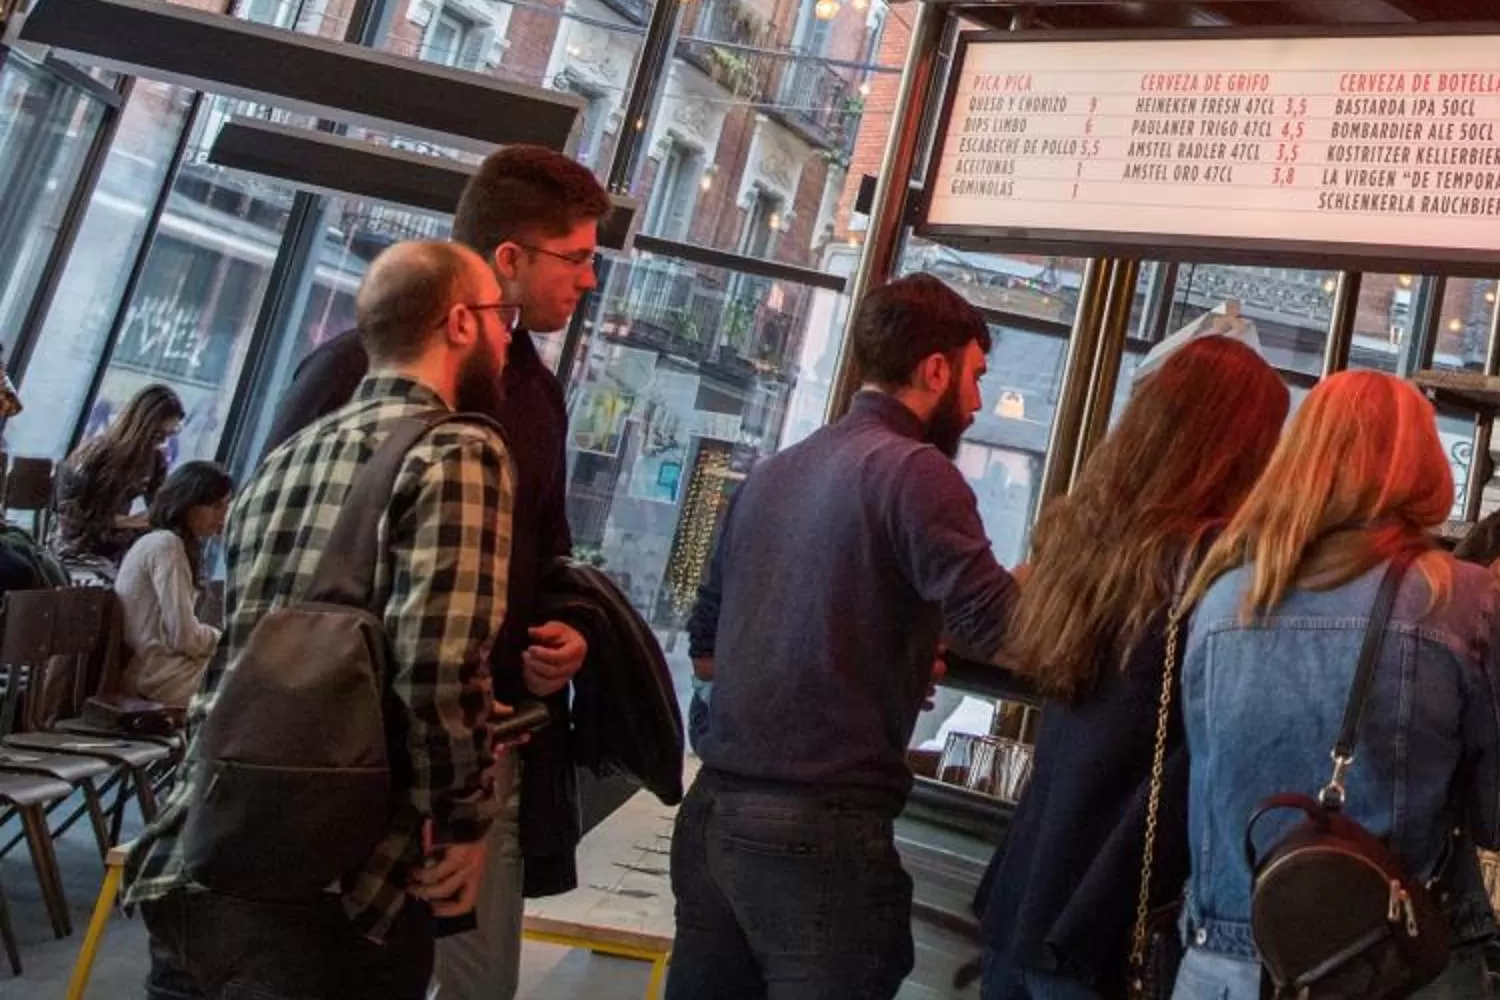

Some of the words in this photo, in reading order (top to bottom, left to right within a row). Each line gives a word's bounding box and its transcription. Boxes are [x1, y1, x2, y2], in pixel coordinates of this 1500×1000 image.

[1141, 73, 1199, 91] CERVEZA
[1204, 74, 1224, 92] DE
[1227, 74, 1269, 92] GRIFO
[1339, 73, 1405, 92] CERVEZA
[1411, 74, 1432, 92] DE
[969, 96, 1004, 111] QUESO
[1008, 96, 1015, 112] Y
[1018, 96, 1067, 112] CHORIZO
[1136, 97, 1197, 114] HEINEKEN
[1201, 98, 1241, 114] FRESH
[1246, 98, 1275, 115] 47CL
[1285, 97, 1307, 118] 3,5
[1335, 98, 1406, 116] BASTARDA
[1411, 99, 1436, 116] IPA
[1441, 99, 1476, 116] 50CL
[963, 117, 990, 133] DIPS
[992, 118, 1027, 133] LIMBO
[1131, 119, 1195, 136] PAULANER
[1200, 120, 1238, 137] TRIGO
[1243, 120, 1272, 137] 47CL
[1281, 121, 1305, 140] 4,5
[1331, 121, 1422, 140] BOMBARDIER
[1428, 122, 1454, 140] ALE
[1460, 123, 1494, 141] 50CL
[959, 138, 1021, 154] ESCABECHE
[1023, 139, 1037, 154] DE
[1042, 140, 1076, 155] POLLO
[1127, 141, 1172, 158] AMSTEL
[1178, 142, 1229, 160] RADLER
[1231, 143, 1260, 160] 47CL
[1276, 144, 1299, 163] 3,5
[1326, 145, 1410, 164] KOSTRITZER
[956, 159, 1015, 174] ACEITUNAS
[1123, 163, 1169, 181] AMSTEL
[1174, 165, 1199, 182] ORO
[1204, 165, 1233, 183] 47CL
[1272, 167, 1295, 187] 3,8
[1322, 170, 1338, 186] LA
[1344, 170, 1396, 187] VIRGEN
[1318, 192, 1415, 213] SCHLENKERLA
